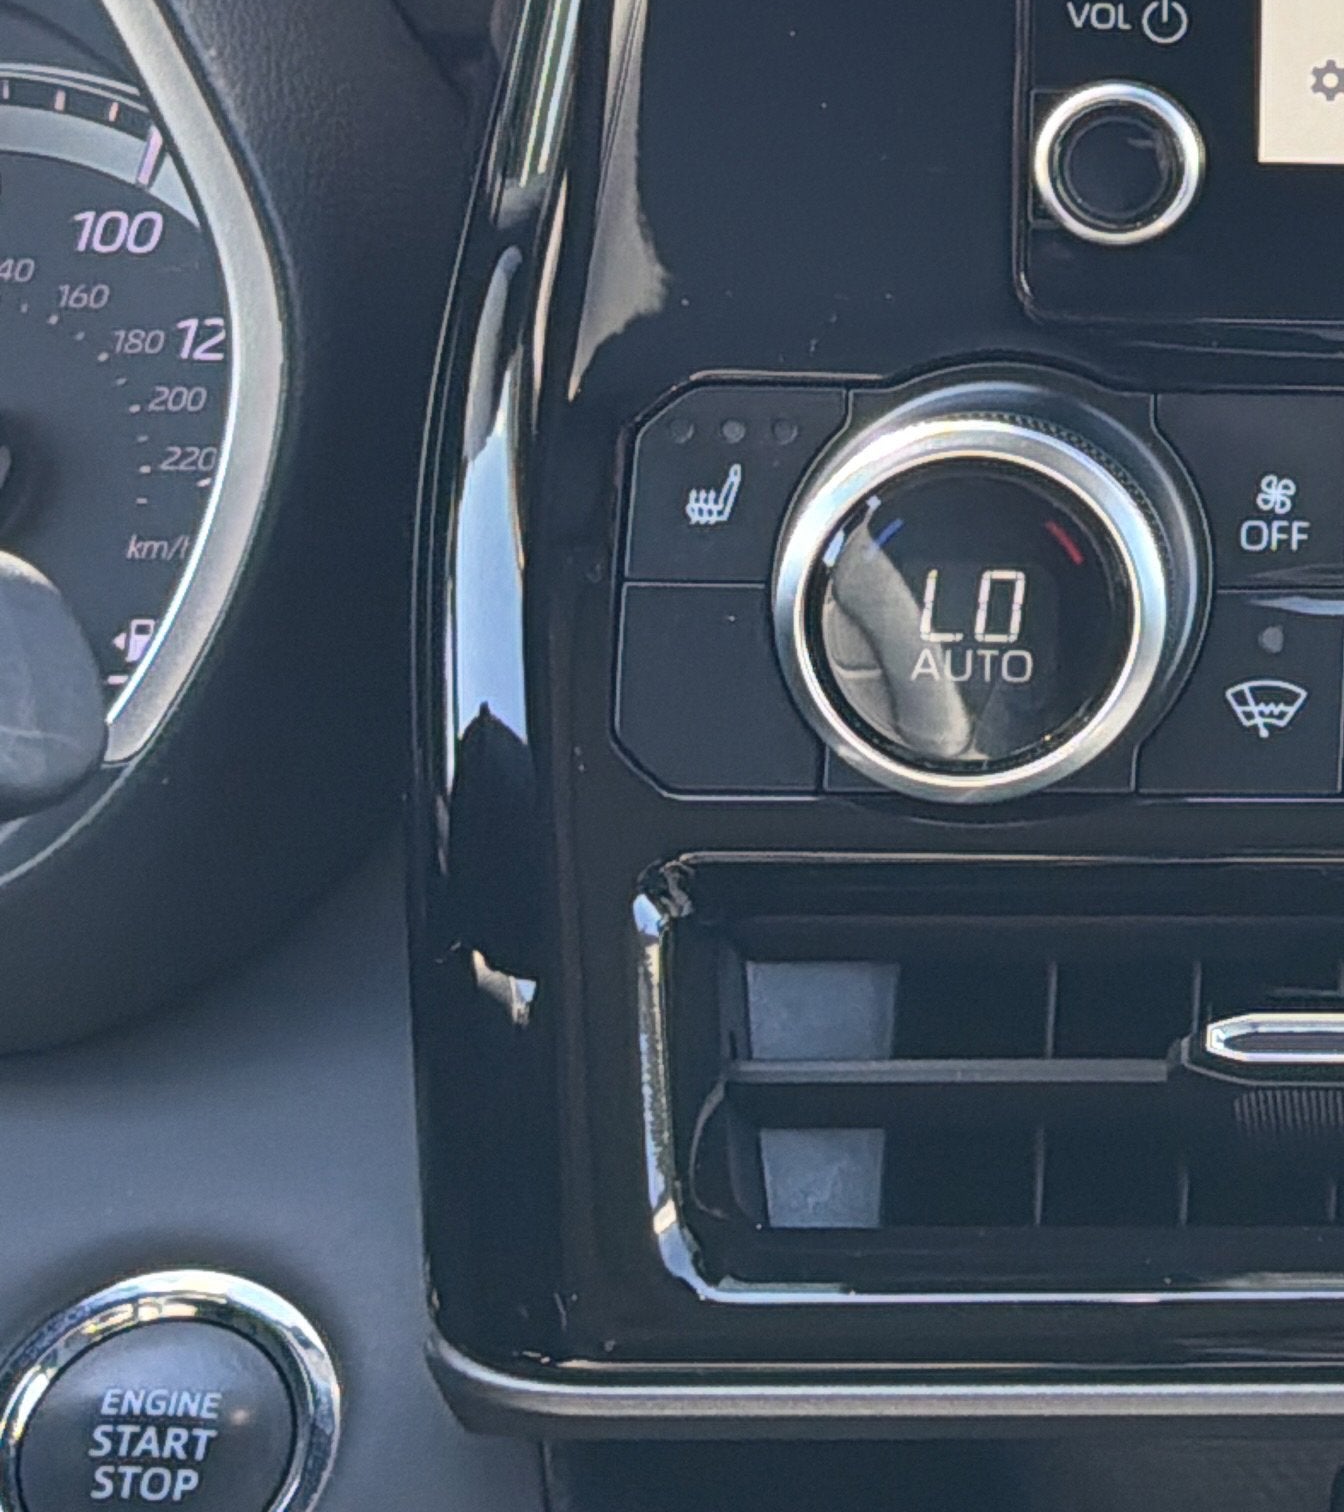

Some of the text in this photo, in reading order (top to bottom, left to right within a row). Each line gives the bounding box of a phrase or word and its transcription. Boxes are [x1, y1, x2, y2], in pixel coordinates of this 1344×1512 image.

[1066, 1, 1131, 30] VOL
[74, 210, 163, 254] 100
[59, 284, 110, 309] 160
[114, 329, 165, 354] 180
[148, 386, 207, 412] 200
[159, 446, 217, 471] 220
[1240, 520, 1310, 551] OFF
[911, 652, 1033, 683] AUTO
[101, 1389, 223, 1419] ENGINE
[88, 1425, 218, 1461] START
[90, 1465, 199, 1501] STOP
